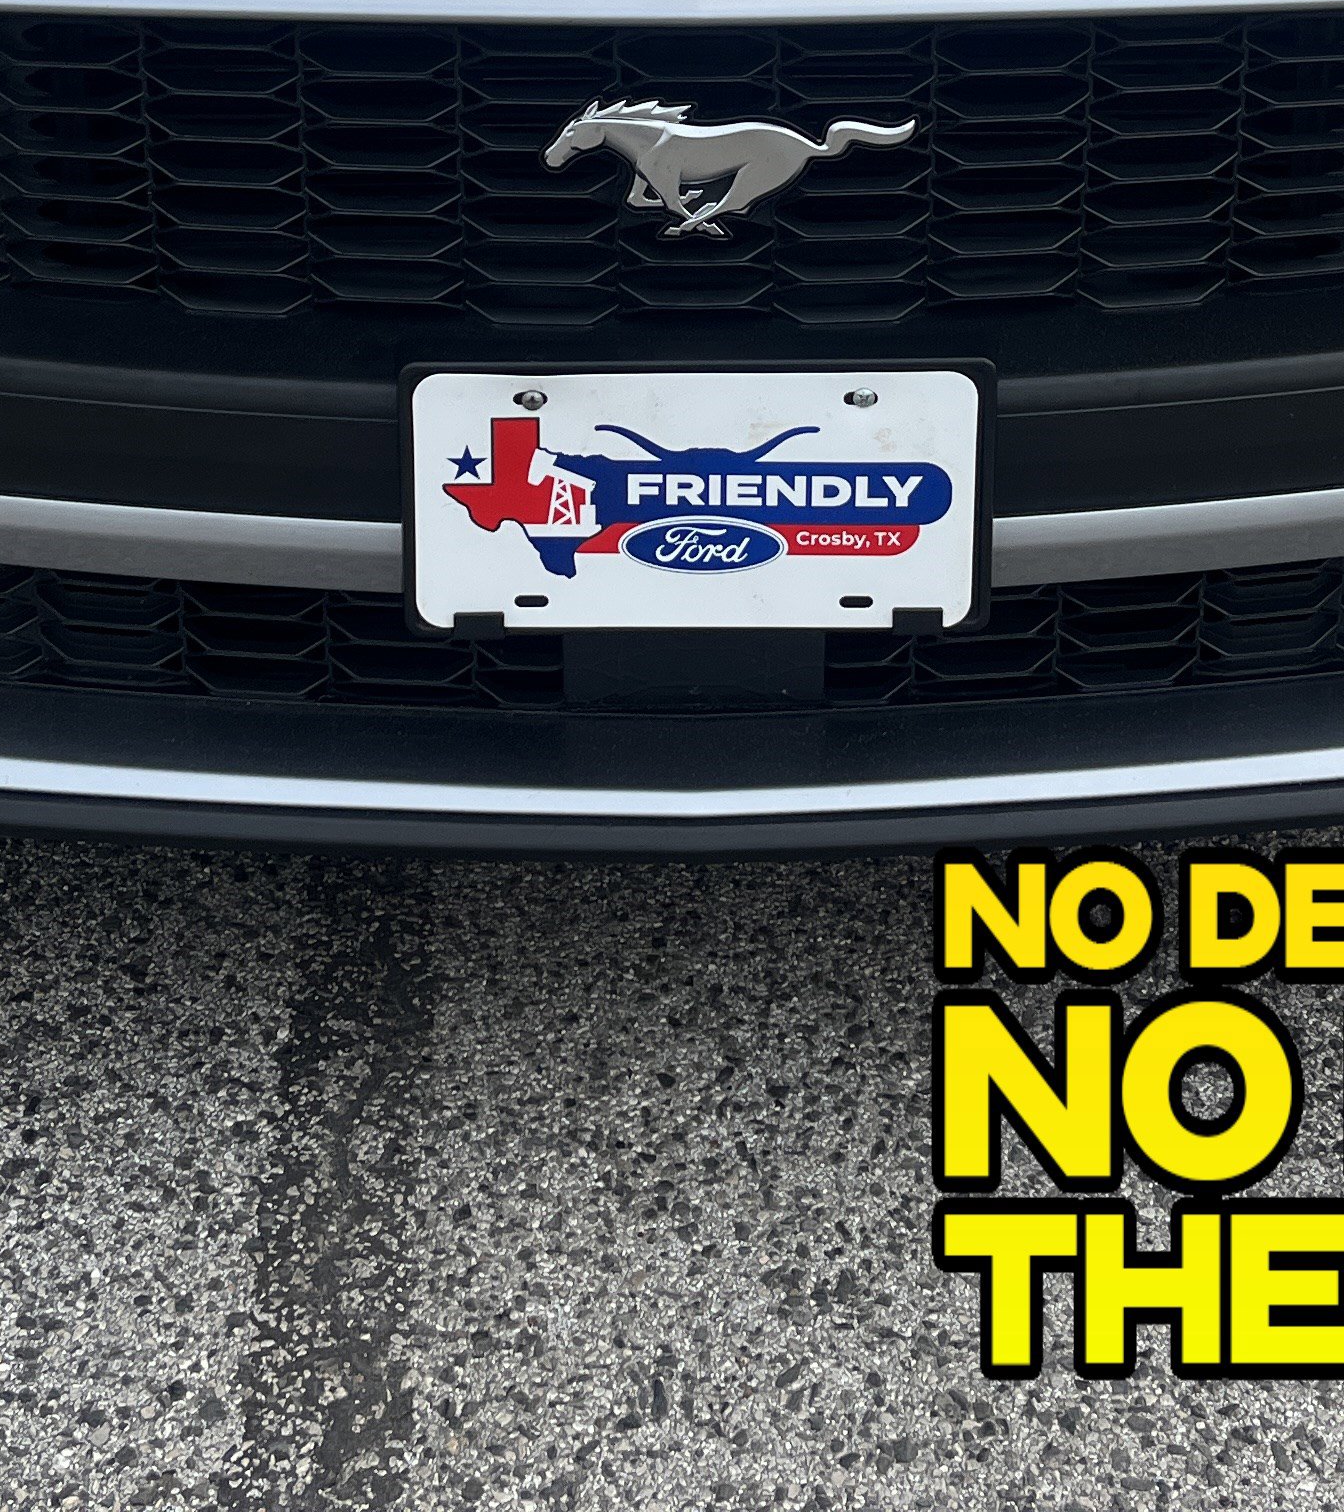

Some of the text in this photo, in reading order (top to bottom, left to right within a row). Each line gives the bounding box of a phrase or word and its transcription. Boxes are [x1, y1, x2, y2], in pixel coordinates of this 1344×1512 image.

[626, 472, 924, 508] FRIENDLY
[655, 525, 751, 563] Ford
[795, 530, 902, 549] Crosby, TX
